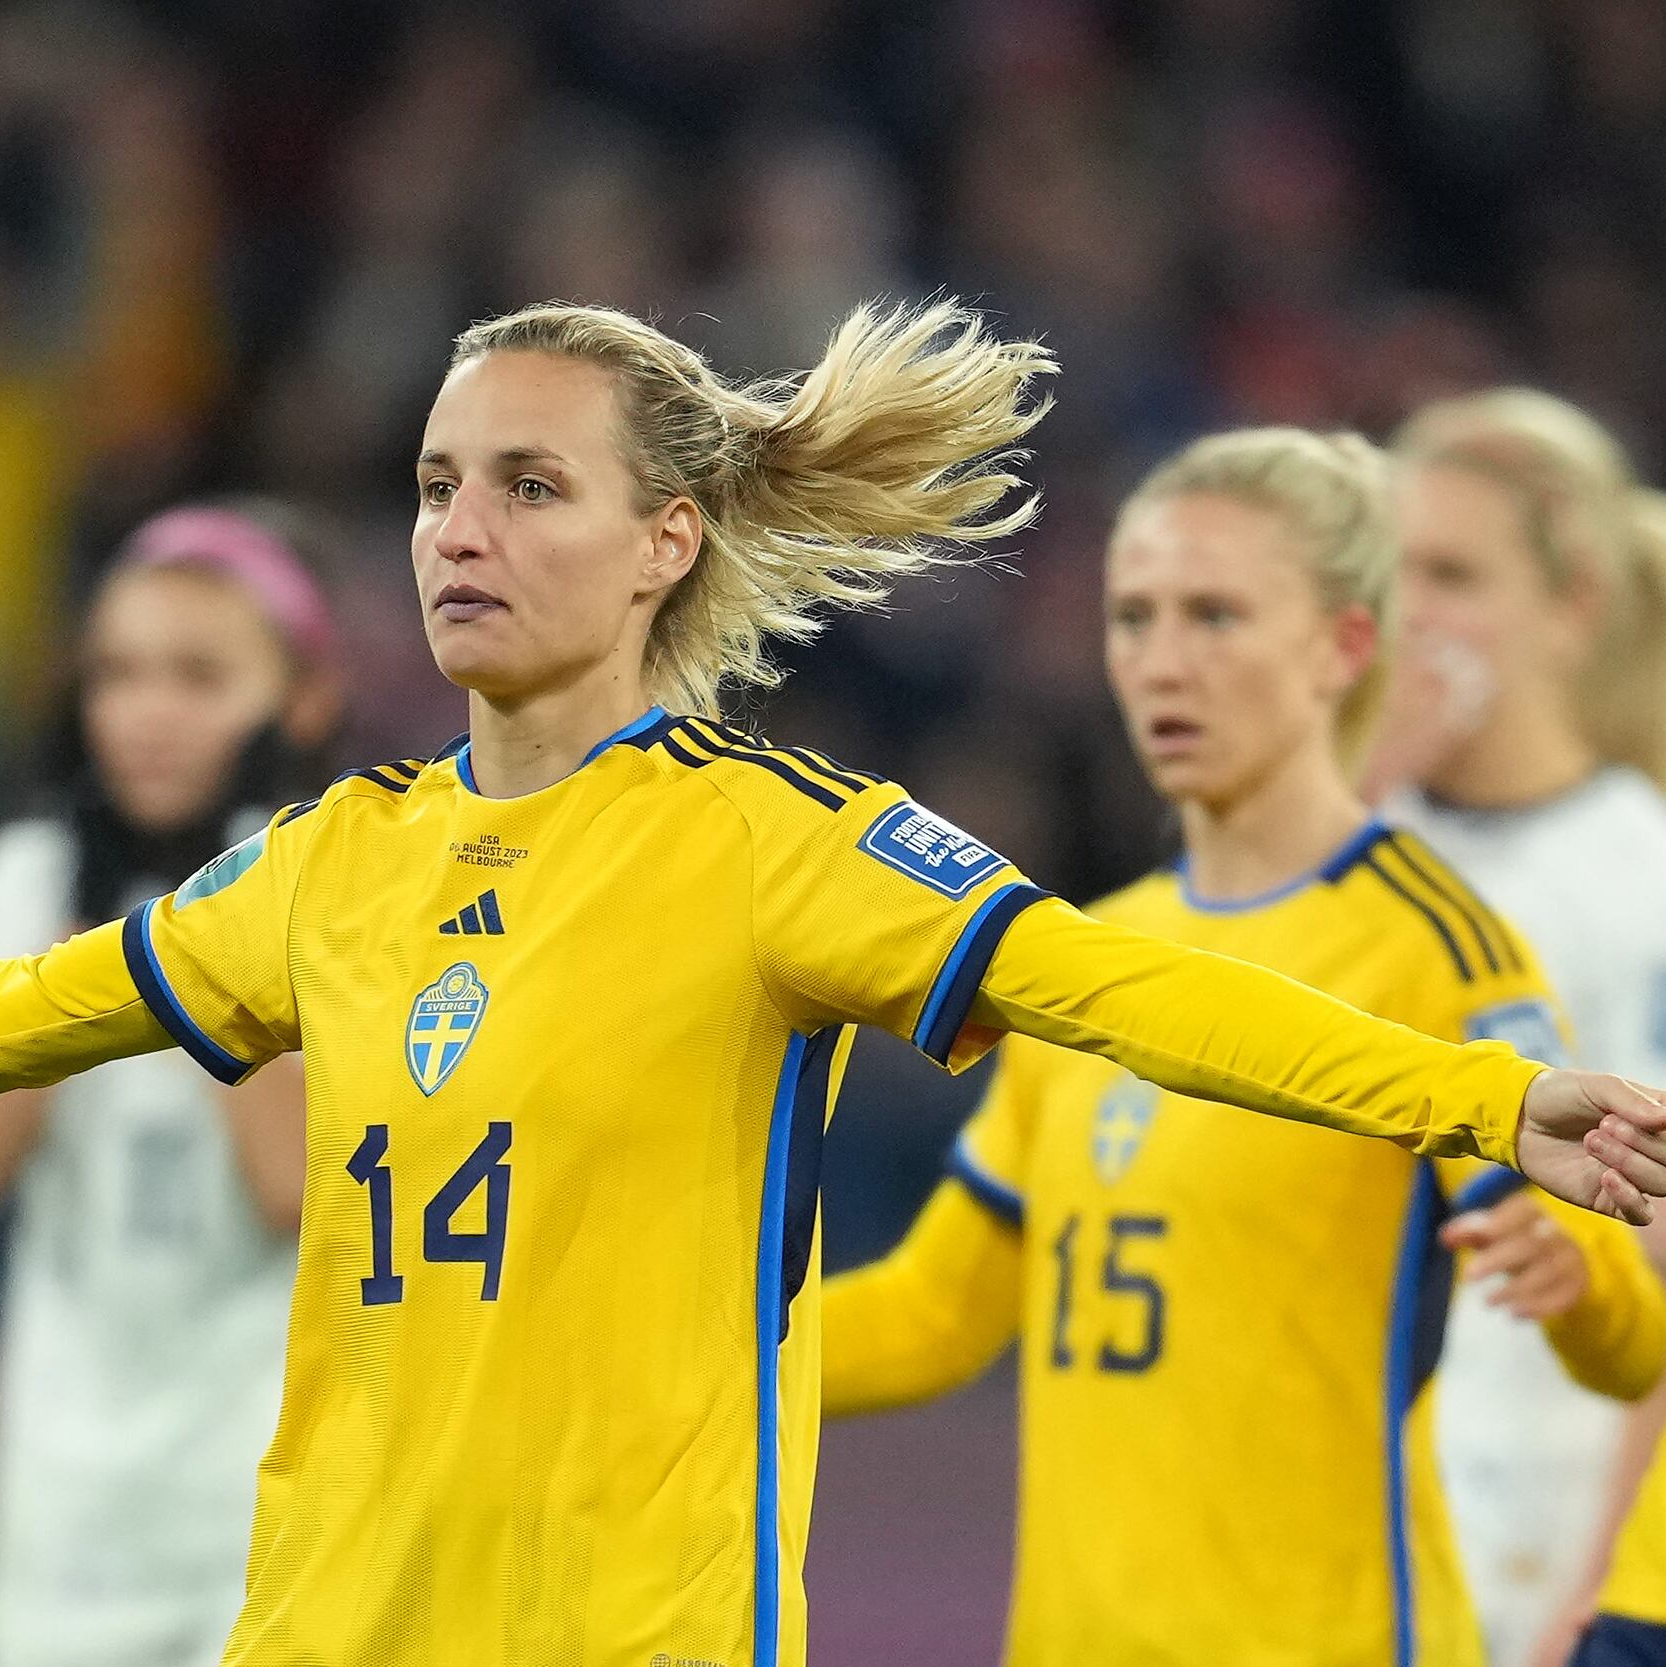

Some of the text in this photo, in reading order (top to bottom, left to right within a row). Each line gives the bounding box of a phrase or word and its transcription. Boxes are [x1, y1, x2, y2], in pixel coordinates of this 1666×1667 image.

[479, 834, 501, 846] USA
[462, 842, 502, 857] AUGUST
[504, 848, 529, 859] 2023
[959, 848, 982, 864] FIFA
[456, 854, 516, 869] MELBOURNE
[425, 1001, 473, 1013] SVERIGE
[345, 1121, 513, 1307] 14
[1051, 1212, 1167, 1376] 15
